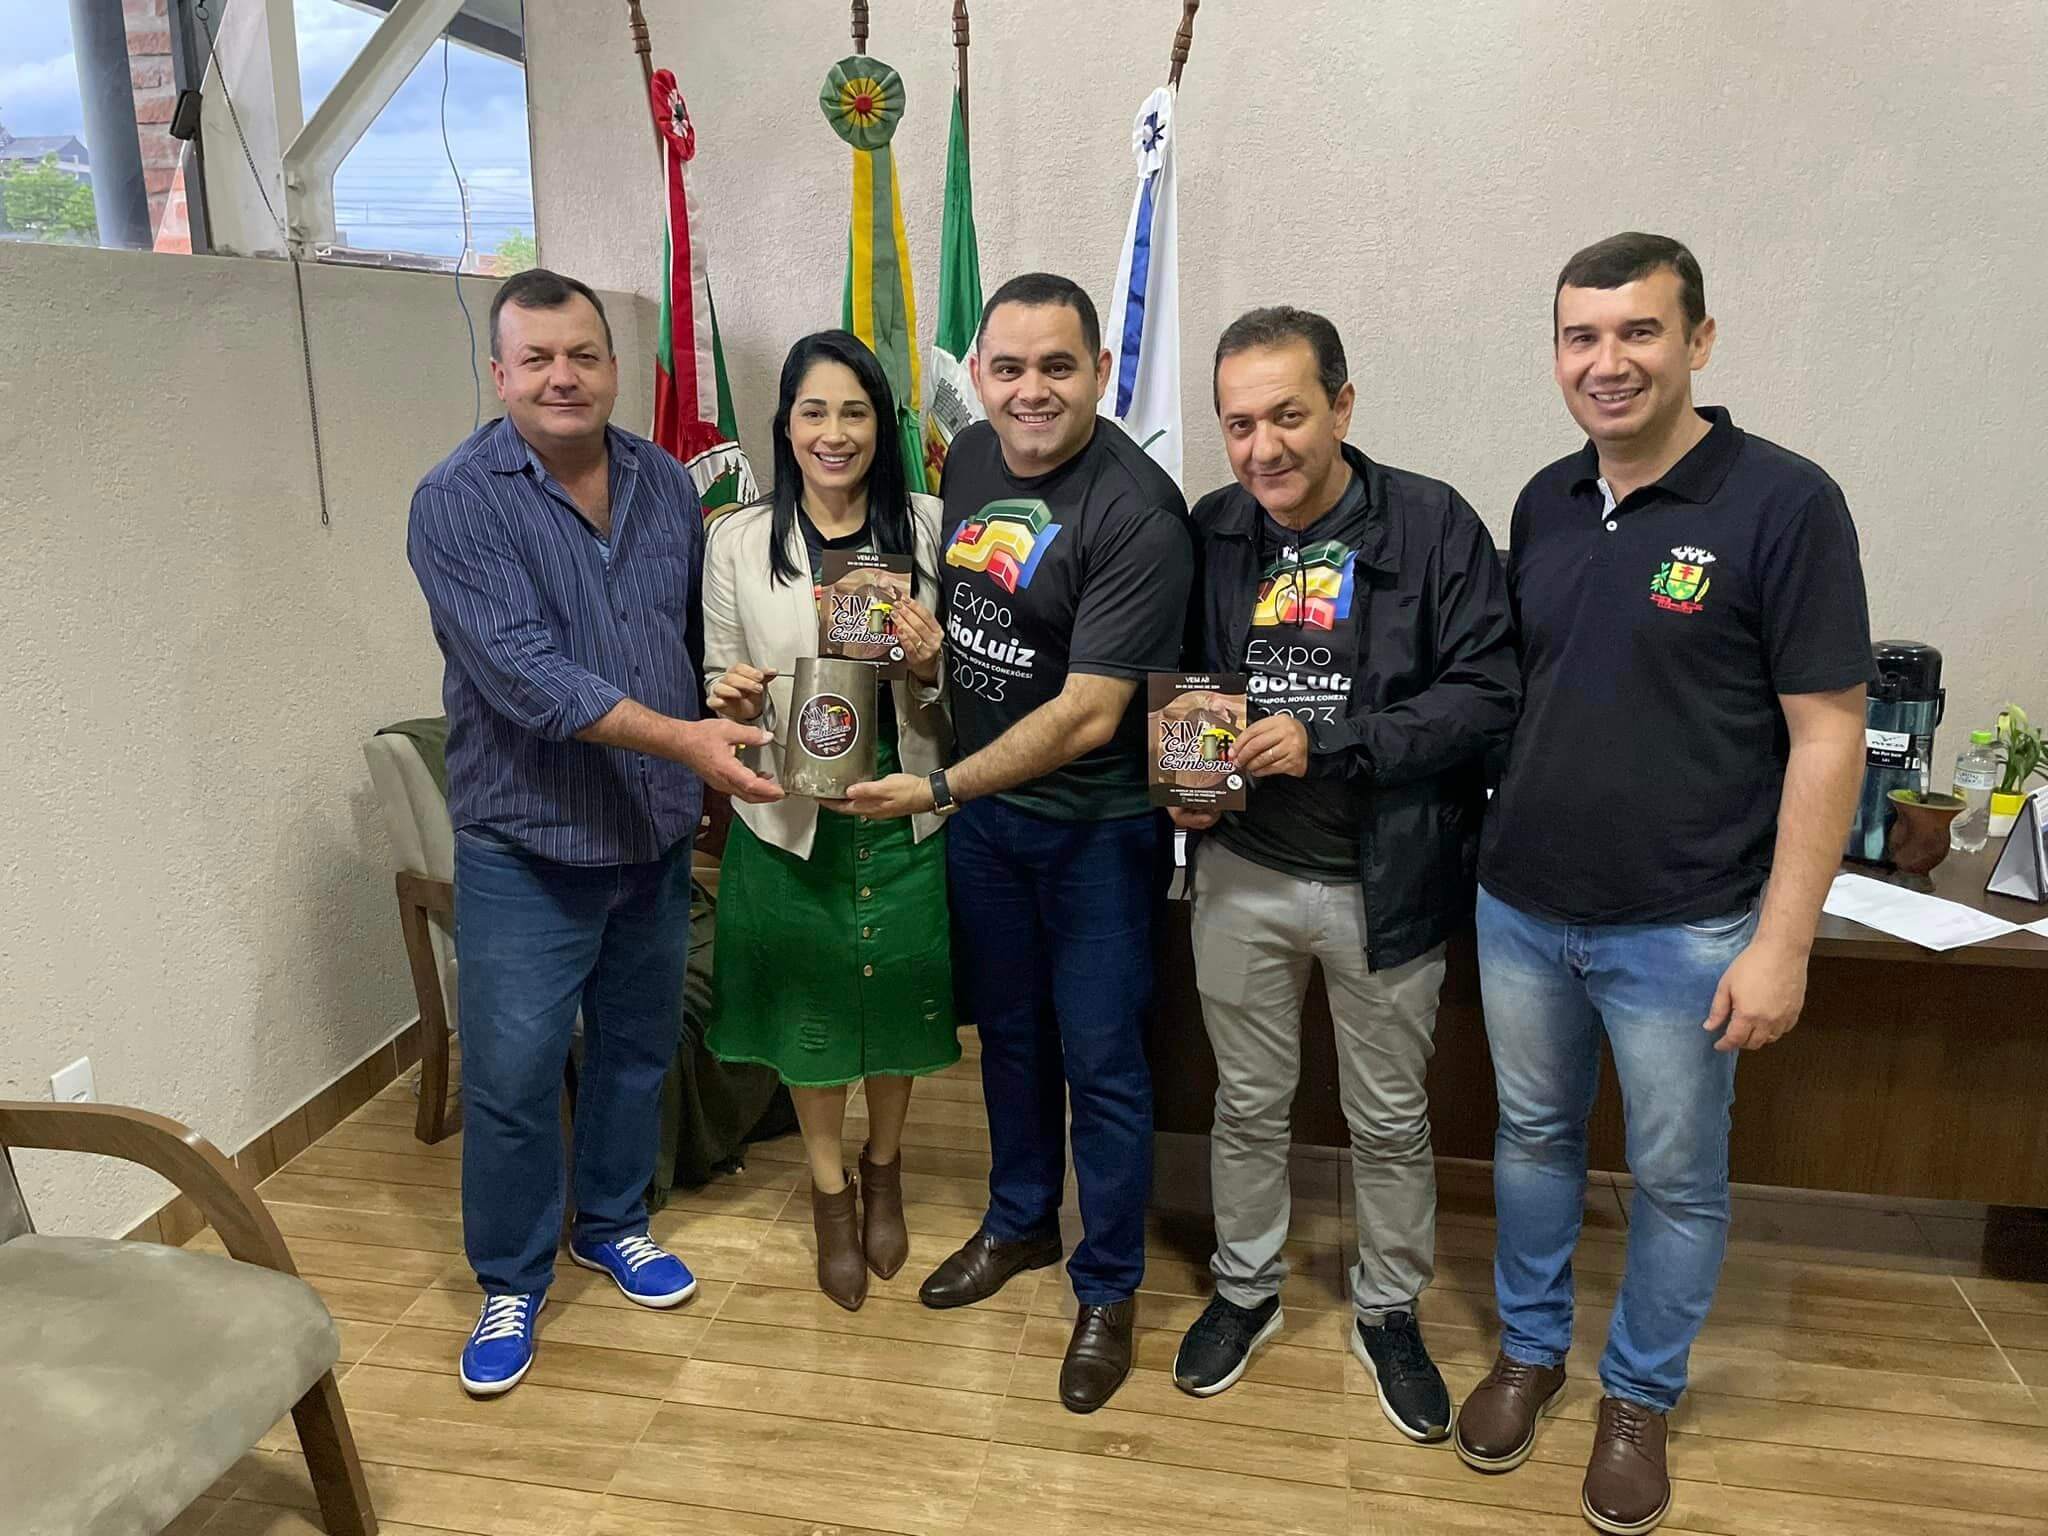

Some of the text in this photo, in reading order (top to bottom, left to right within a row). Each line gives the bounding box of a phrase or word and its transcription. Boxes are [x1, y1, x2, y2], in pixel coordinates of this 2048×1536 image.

[831, 594, 872, 616] XIV
[953, 582, 1012, 628] Expo
[834, 610, 869, 631] Café
[828, 624, 899, 644] Cambona
[1245, 639, 1332, 671] Expo
[952, 656, 1007, 702] 2023
[991, 664, 1033, 680] CONEXÕES!
[1246, 671, 1352, 694] ãoLuiz
[1160, 720, 1205, 743] XIV
[1164, 736, 1201, 760] Café
[1159, 752, 1236, 773] Cambona
